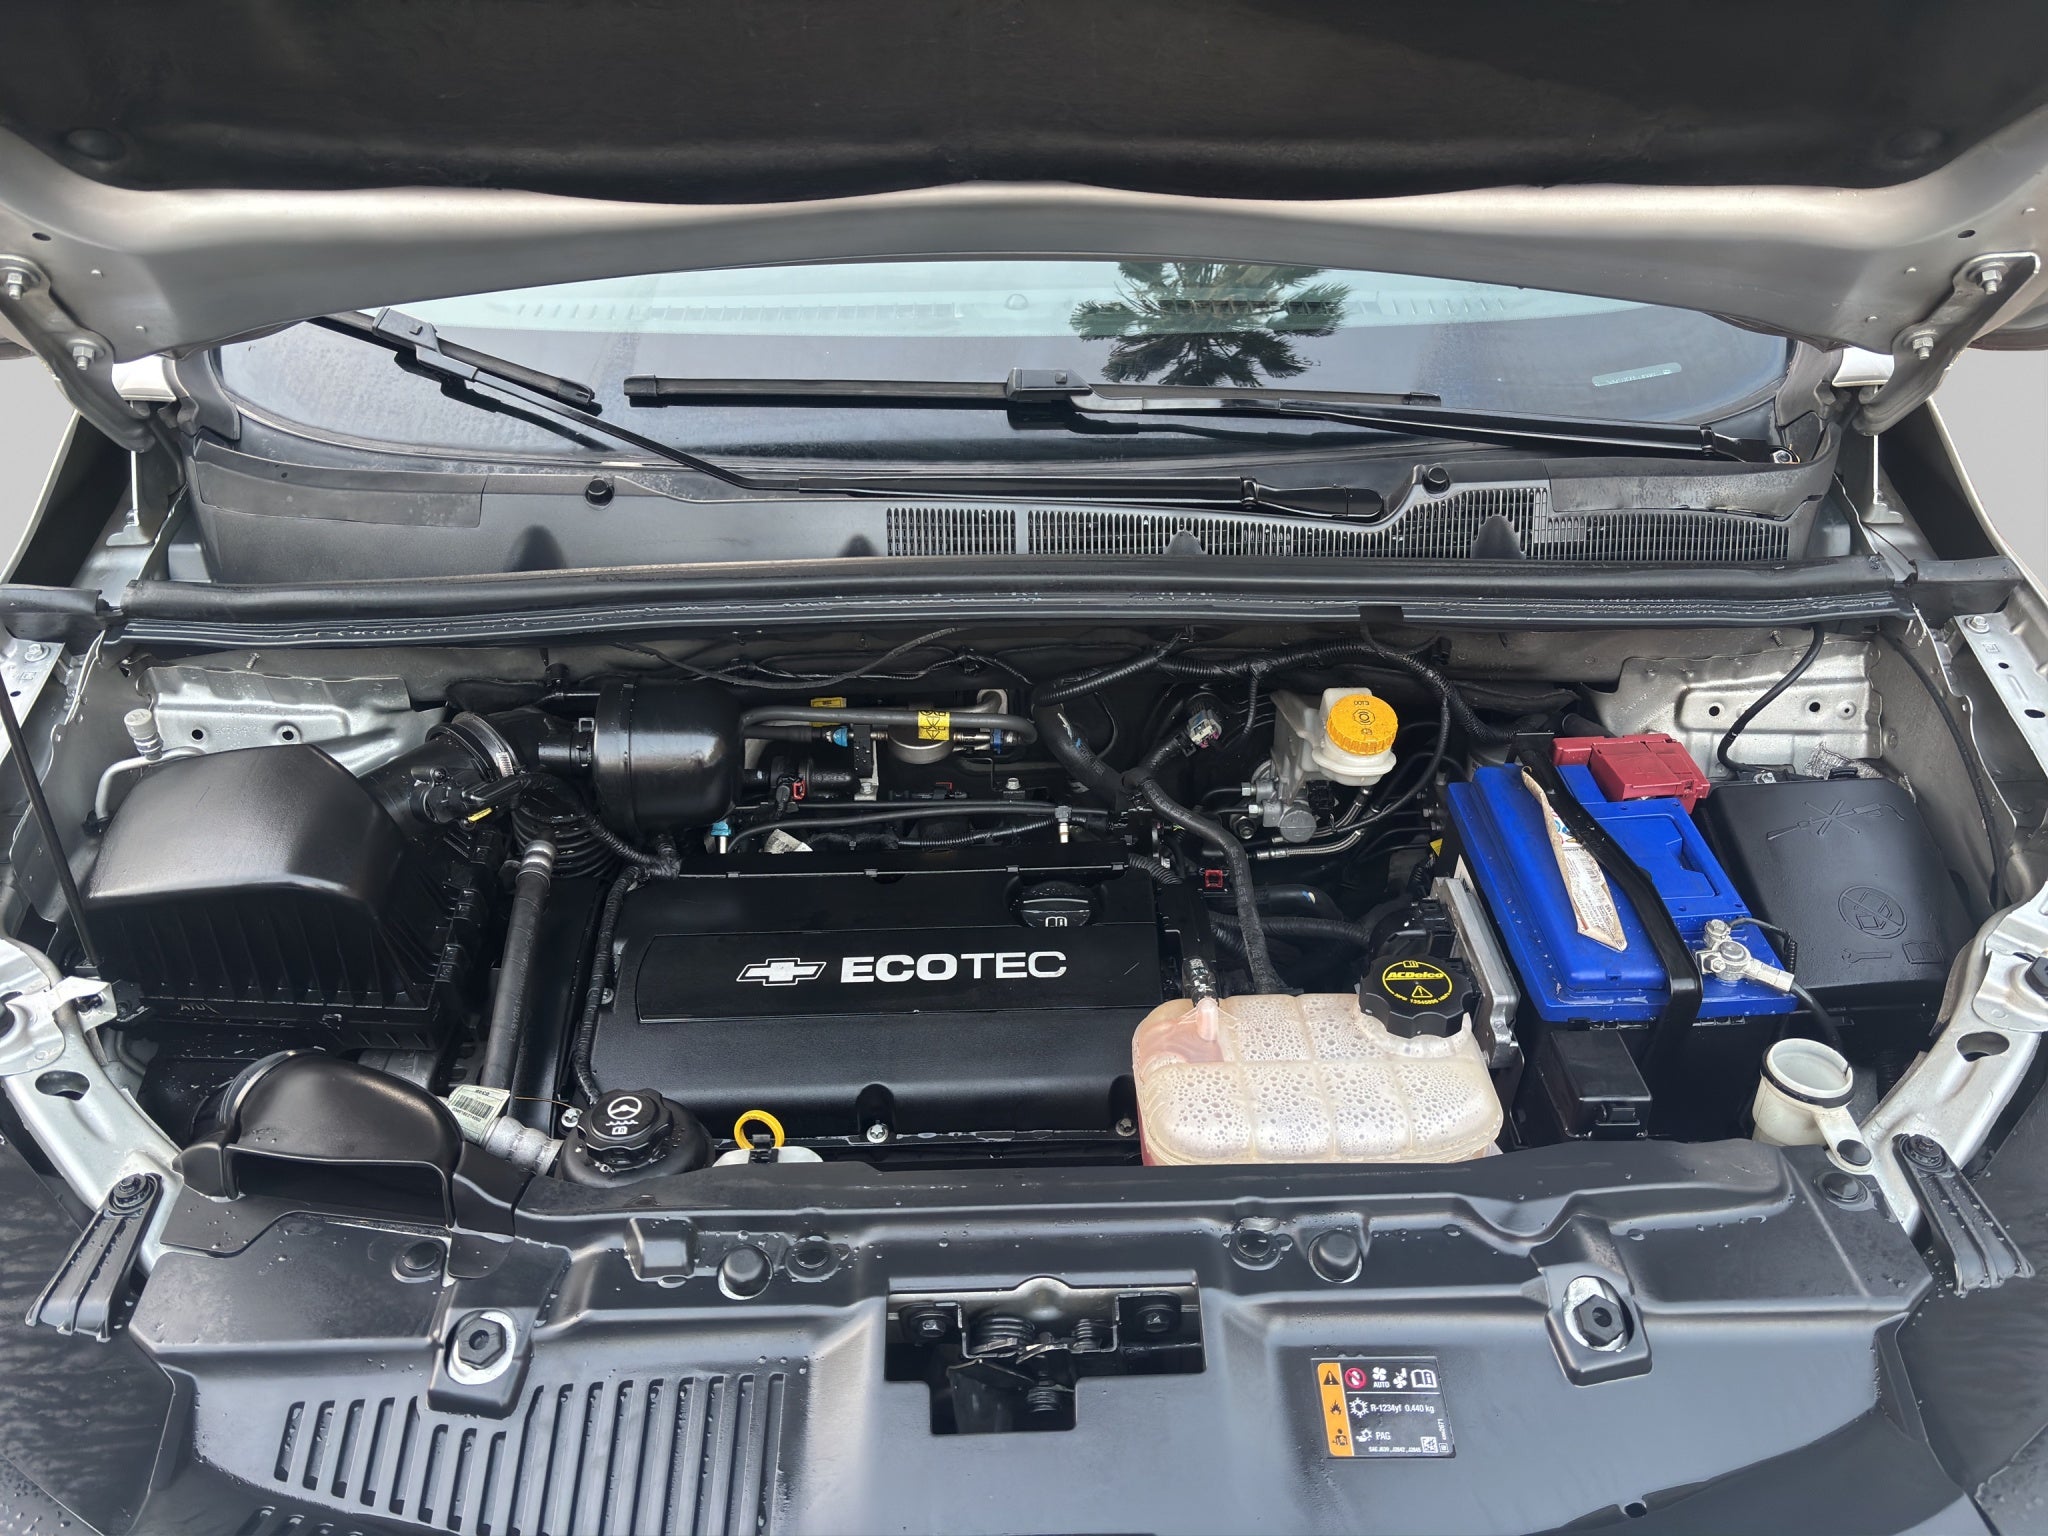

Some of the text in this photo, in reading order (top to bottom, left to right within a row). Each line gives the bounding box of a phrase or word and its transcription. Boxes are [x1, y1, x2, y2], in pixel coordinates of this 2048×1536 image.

[840, 951, 1068, 983] ECOTEC
[1386, 971, 1445, 980] ACDelco
[1370, 1403, 1435, 1414] R-1234yf 0.440 kg
[1375, 1431, 1391, 1440] PAG
